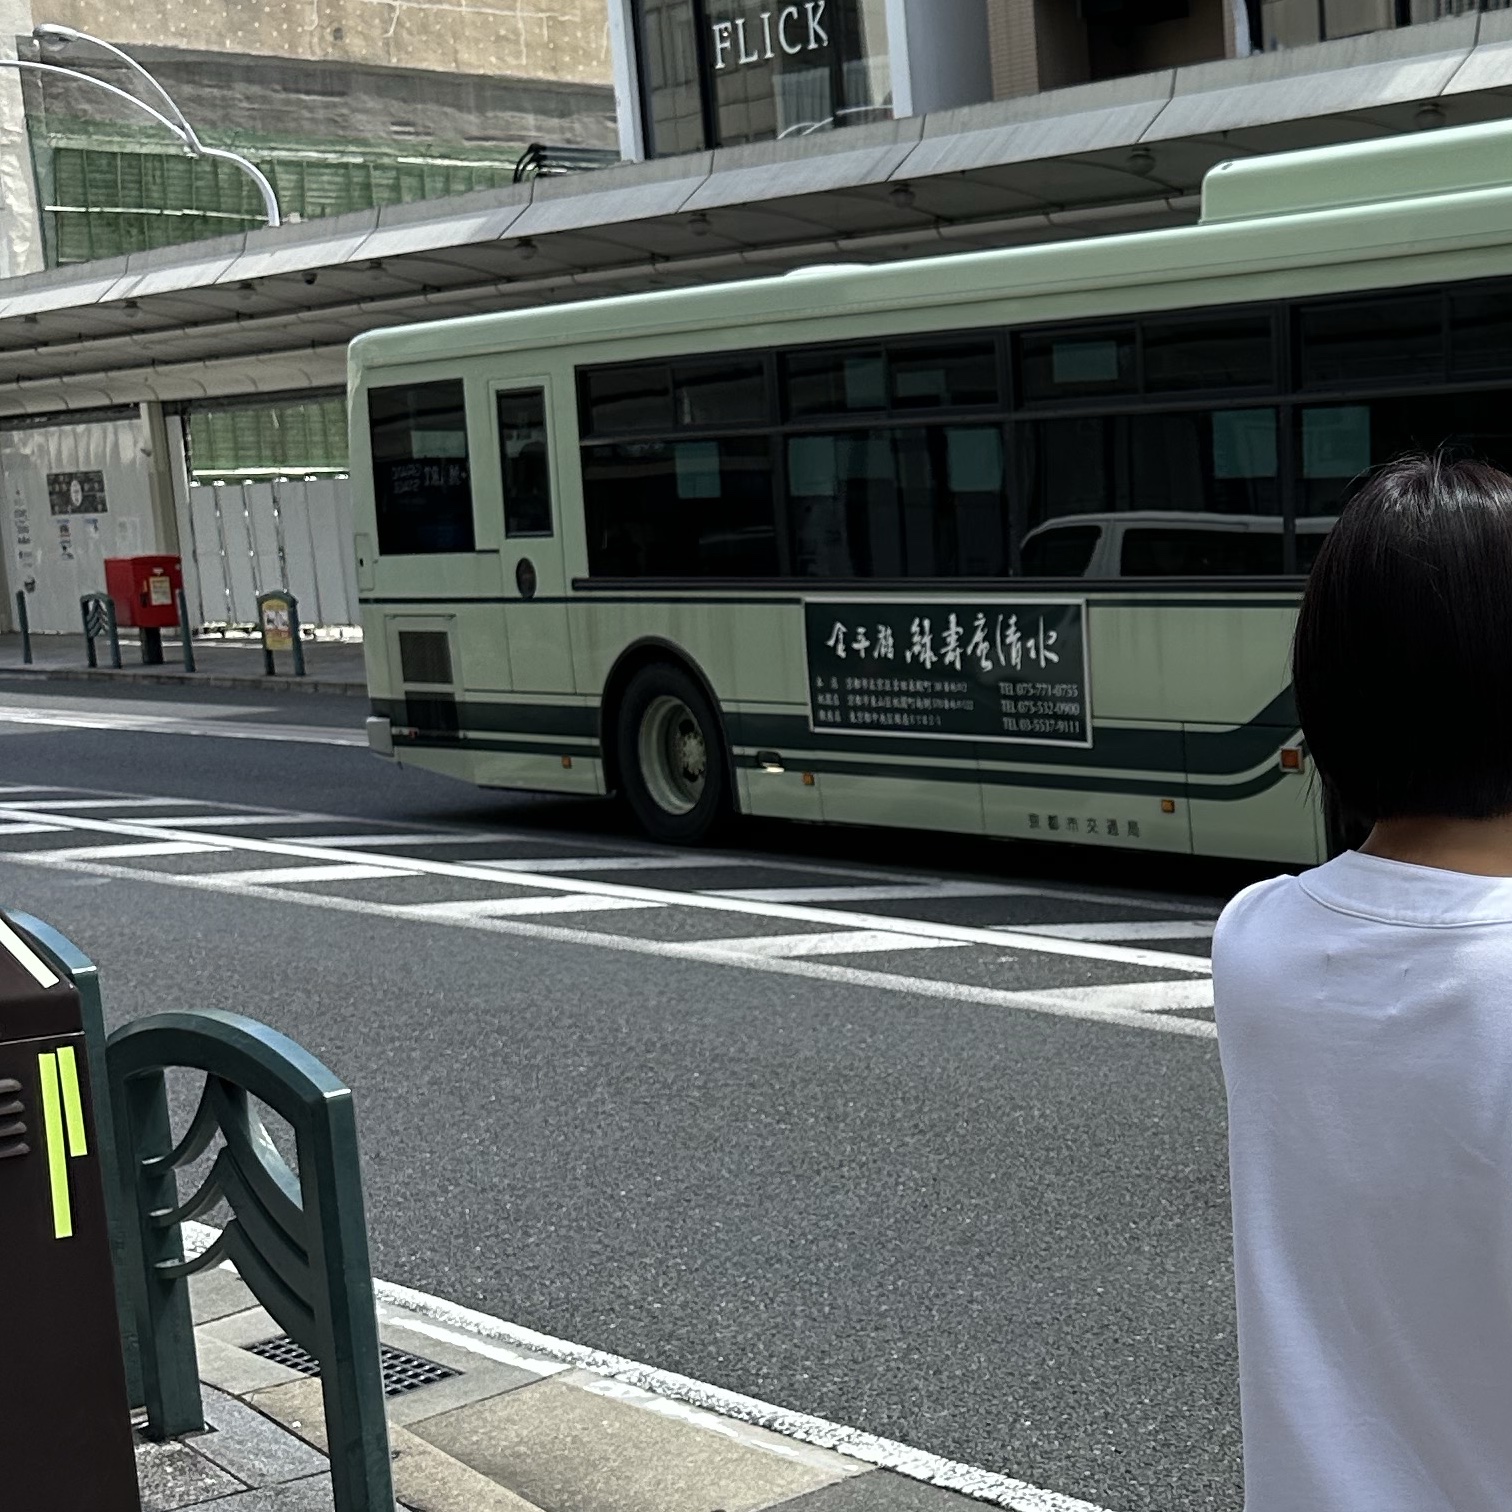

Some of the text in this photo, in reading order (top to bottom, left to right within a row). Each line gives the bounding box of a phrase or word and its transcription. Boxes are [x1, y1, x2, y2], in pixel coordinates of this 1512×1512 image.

[712, 0, 829, 70] FLICK
[999, 681, 1014, 696] TEL
[1000, 699, 1016, 714] TEL
[1002, 717, 1018, 731] TEL
[1028, 813, 1140, 838] 京都市交通局
